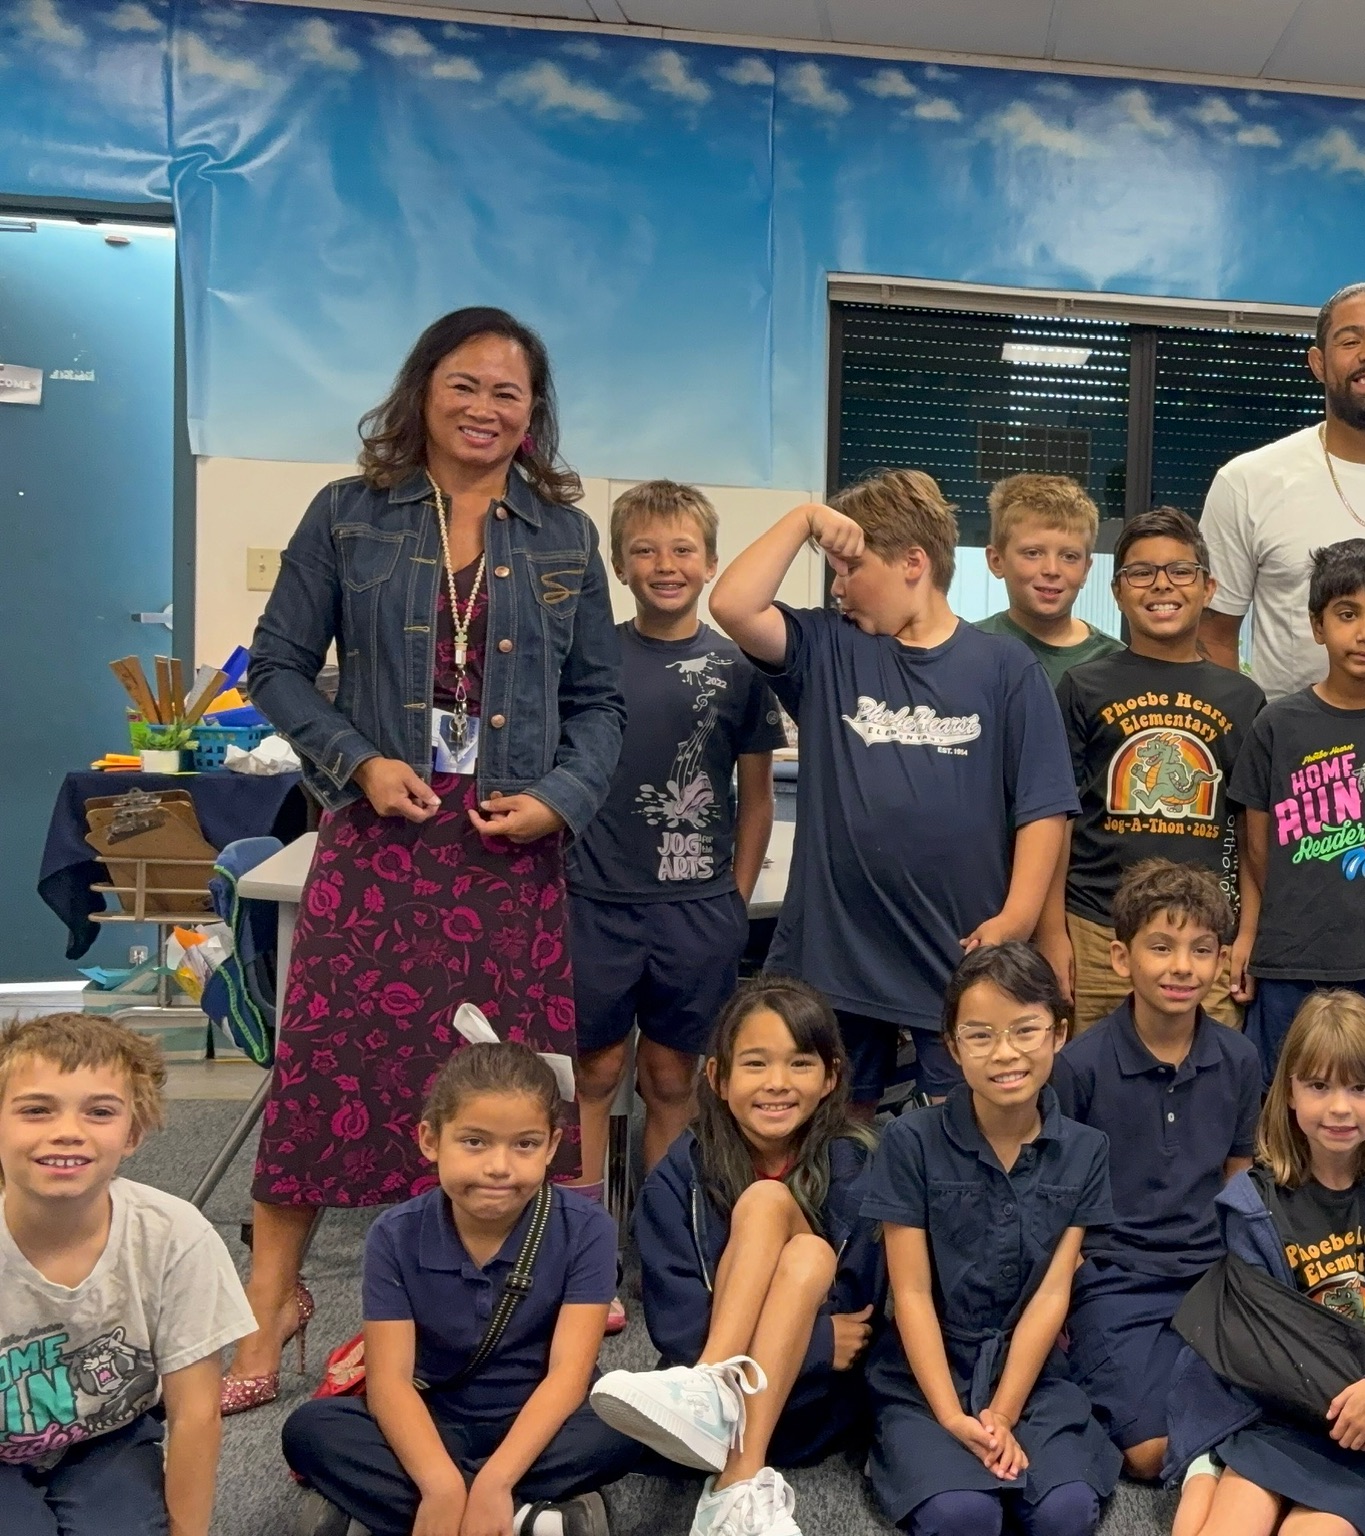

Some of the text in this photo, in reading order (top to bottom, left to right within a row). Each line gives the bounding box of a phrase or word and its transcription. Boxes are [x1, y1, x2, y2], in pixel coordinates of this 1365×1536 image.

[705, 675, 728, 689] 2022
[1102, 692, 1233, 735] Phoebe Hearst
[1120, 713, 1217, 743] Elementary
[1291, 752, 1356, 796] HOME
[1274, 777, 1362, 846] RUN
[1104, 816, 1221, 839] Jog-A-Thon 2025
[657, 832, 702, 856] JOG
[657, 856, 714, 881] ARTS
